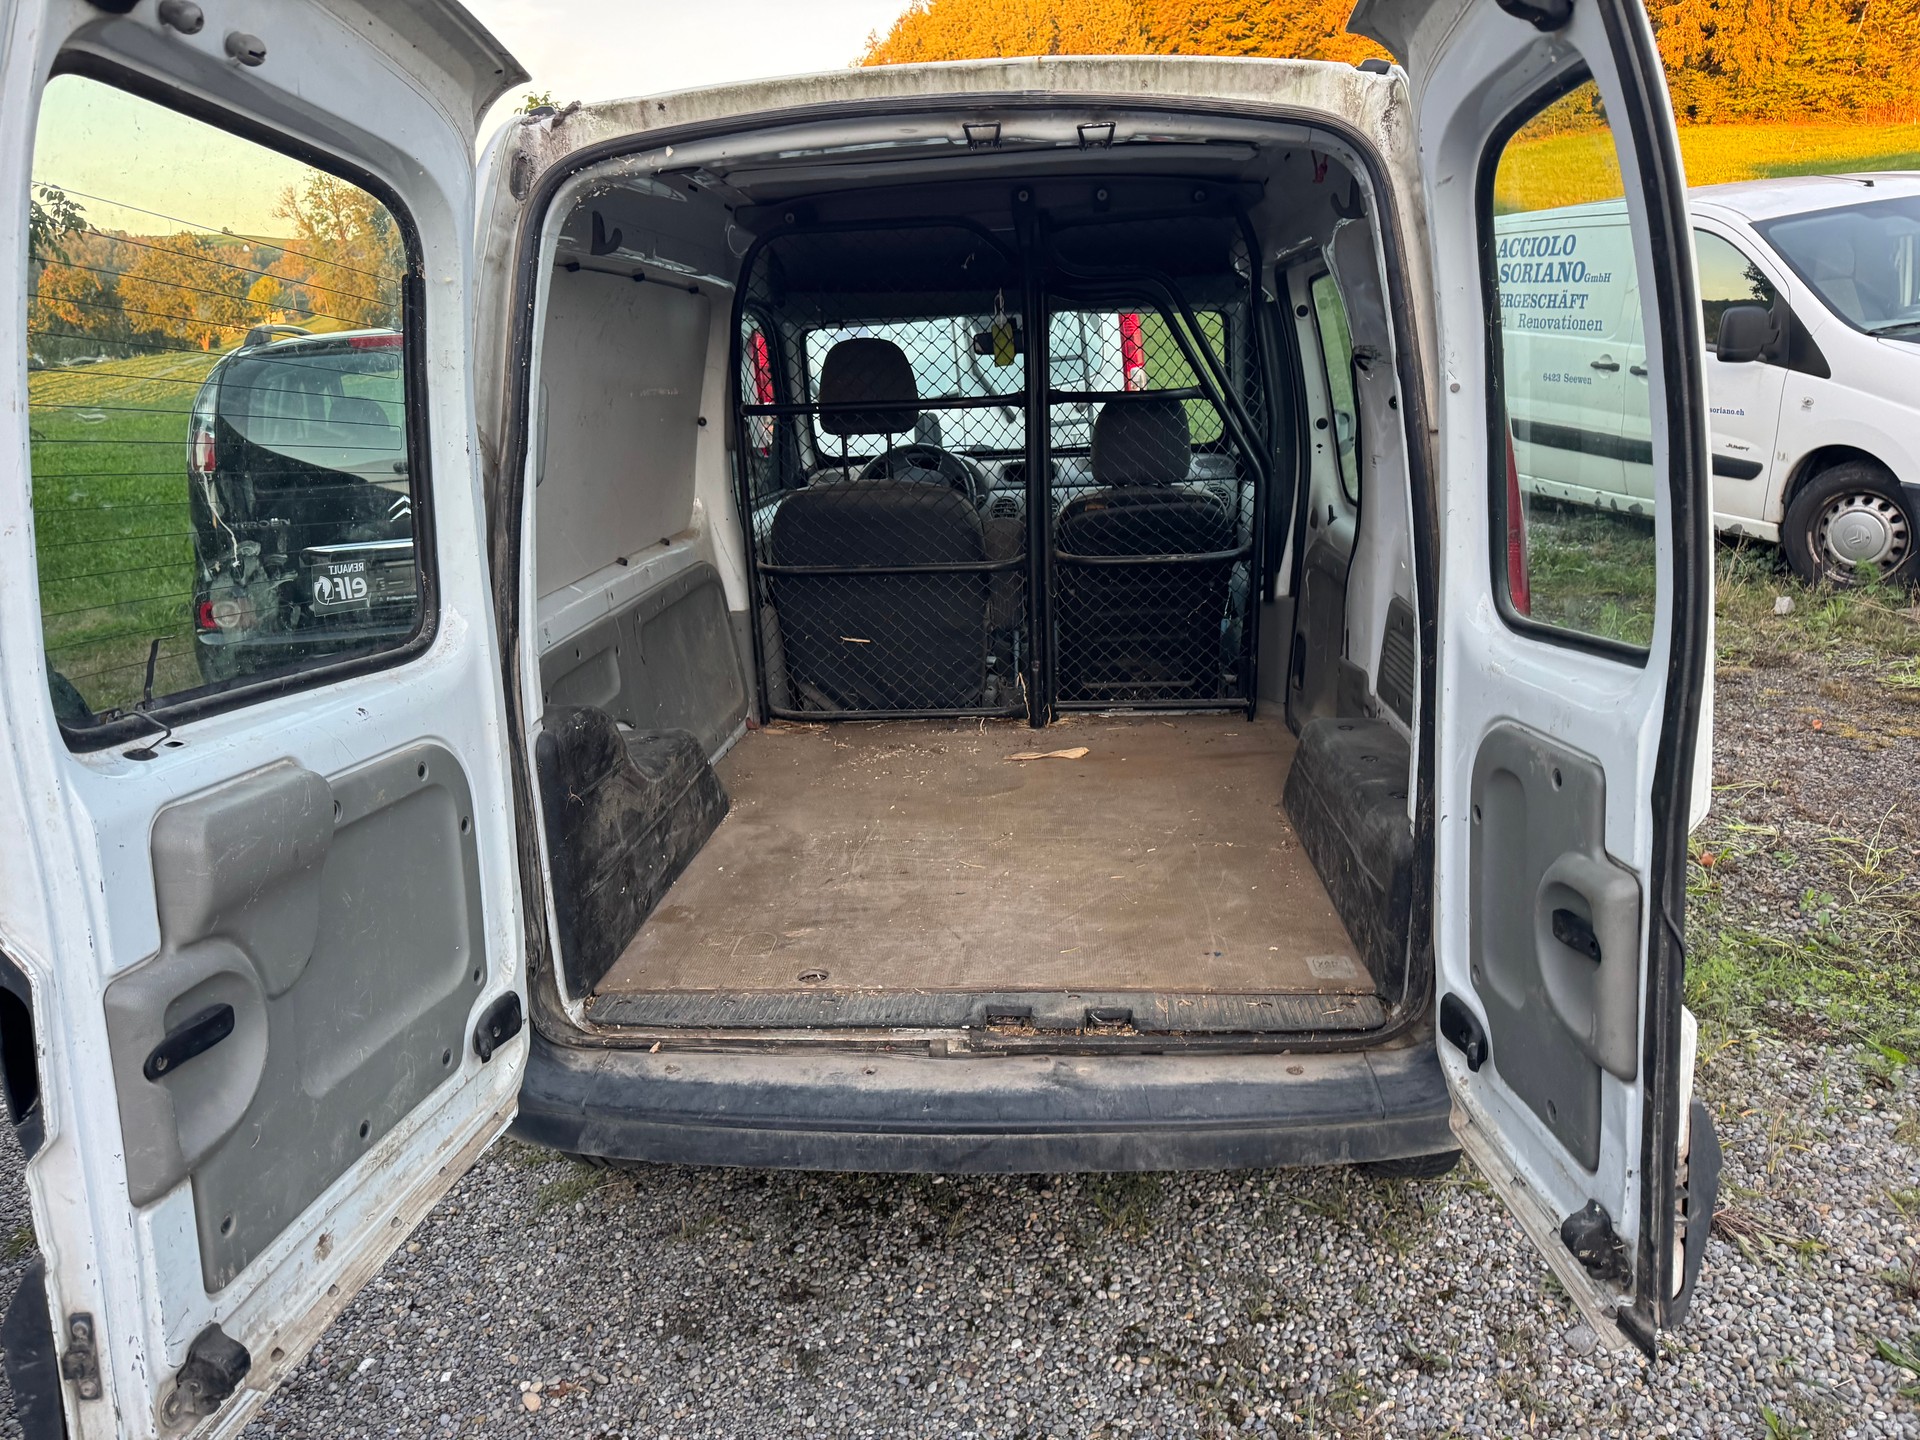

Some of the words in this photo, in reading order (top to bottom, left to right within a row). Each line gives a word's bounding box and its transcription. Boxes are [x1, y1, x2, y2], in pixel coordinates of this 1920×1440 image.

[1497, 234, 1577, 258] ACCIOLO
[1500, 261, 1586, 283] SORIANO
[1584, 272, 1612, 283] GmbH
[1518, 313, 1603, 331] Renovationen
[1563, 373, 1592, 385] Seewen
